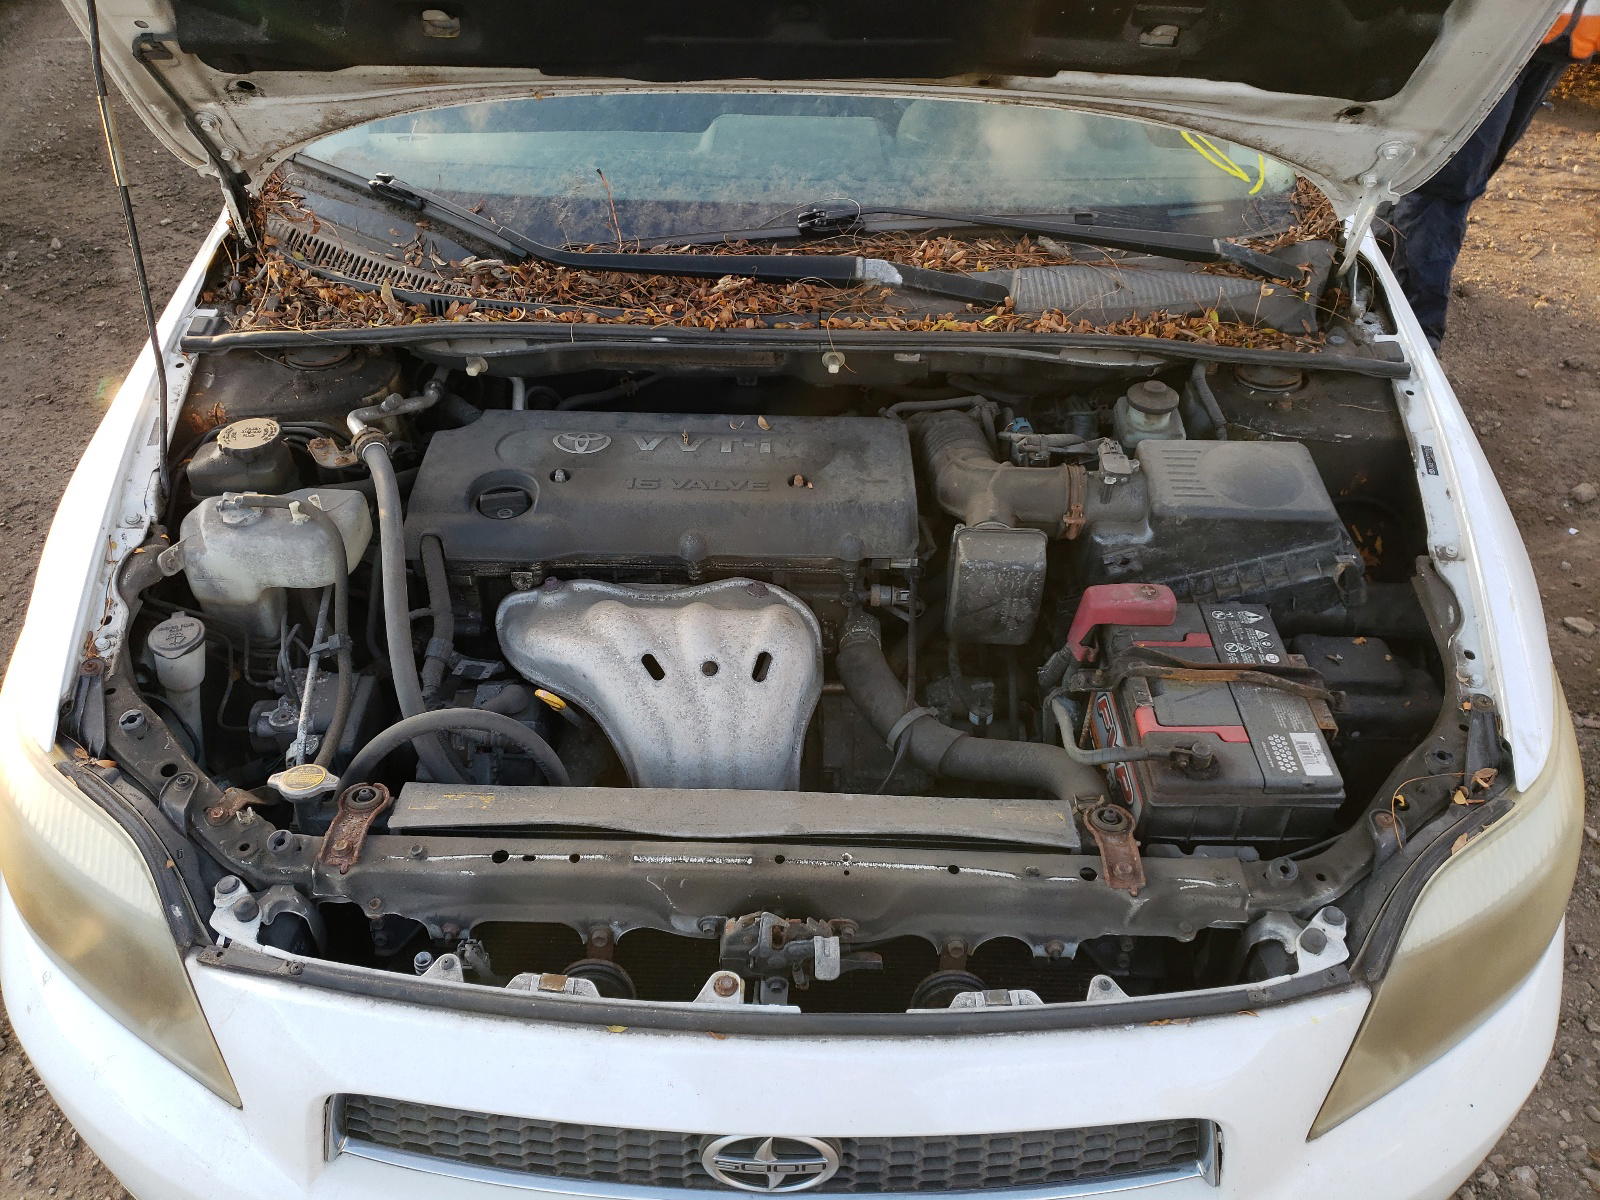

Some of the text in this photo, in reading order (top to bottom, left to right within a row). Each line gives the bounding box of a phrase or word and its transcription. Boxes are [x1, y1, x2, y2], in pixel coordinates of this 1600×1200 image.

[627, 477, 770, 492] 16 VALVE
[714, 1160, 827, 1174] SCION
